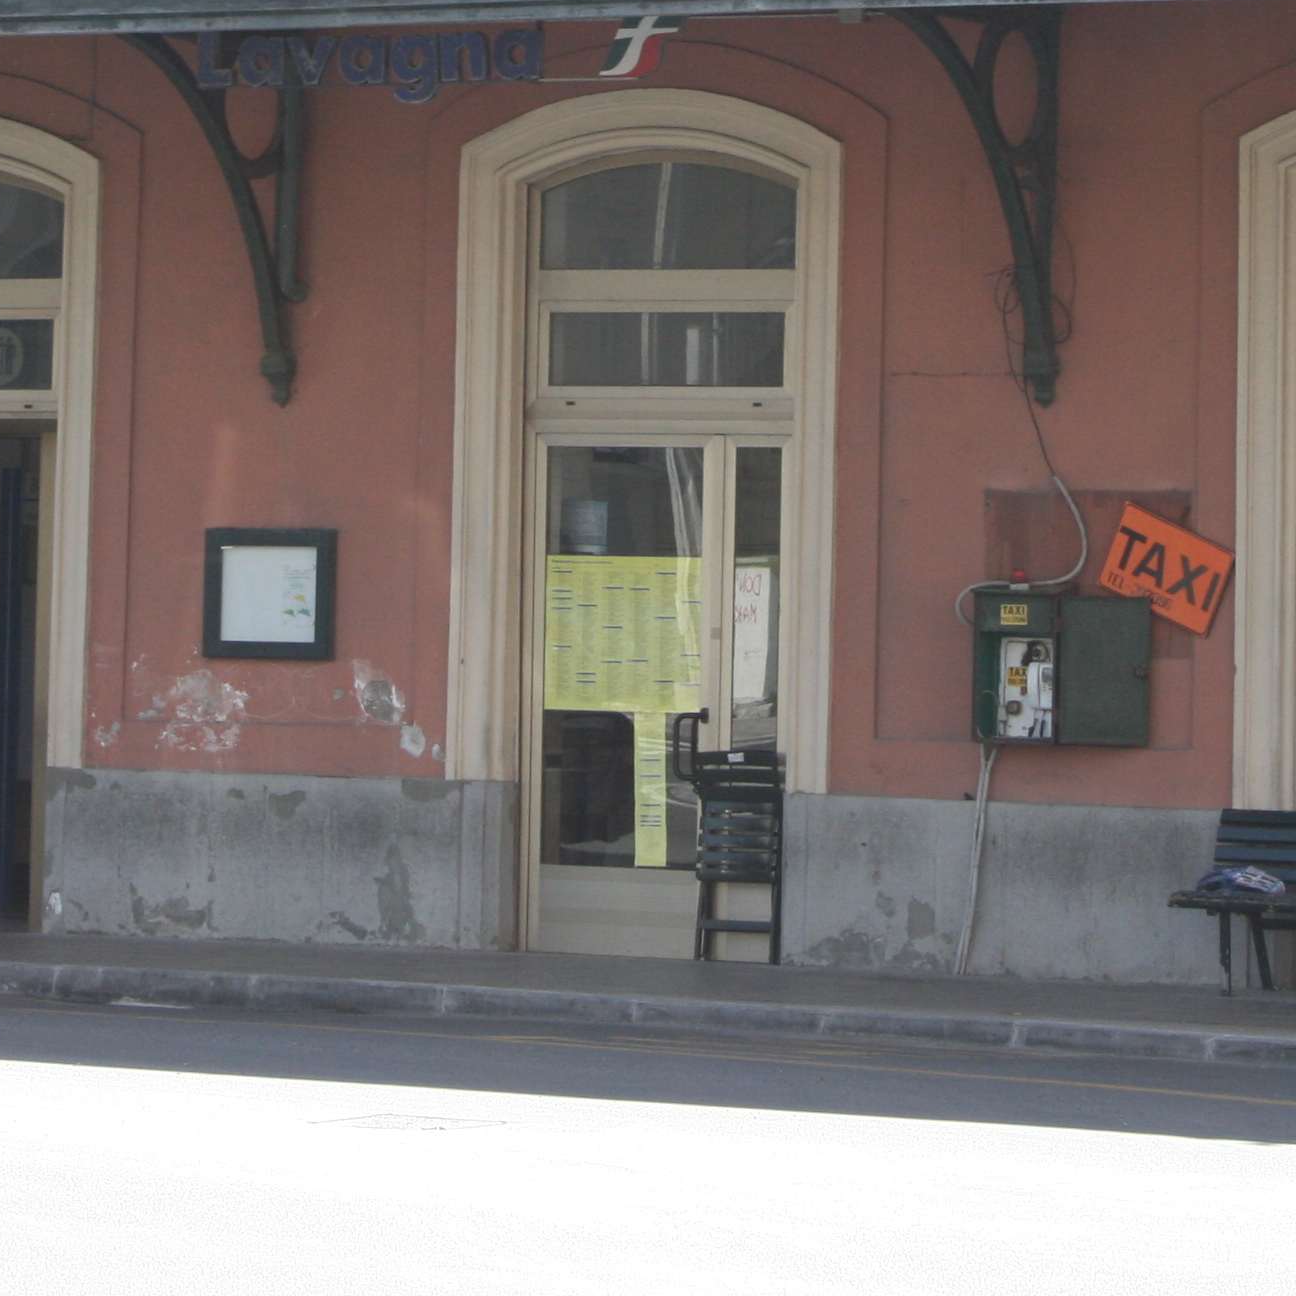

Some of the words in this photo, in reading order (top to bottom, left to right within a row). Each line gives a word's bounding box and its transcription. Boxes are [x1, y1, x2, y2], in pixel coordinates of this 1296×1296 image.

[196, 28, 544, 104] Lavagna
[1119, 525, 1221, 612] TAXI
[1002, 606, 1025, 616] TAXI
